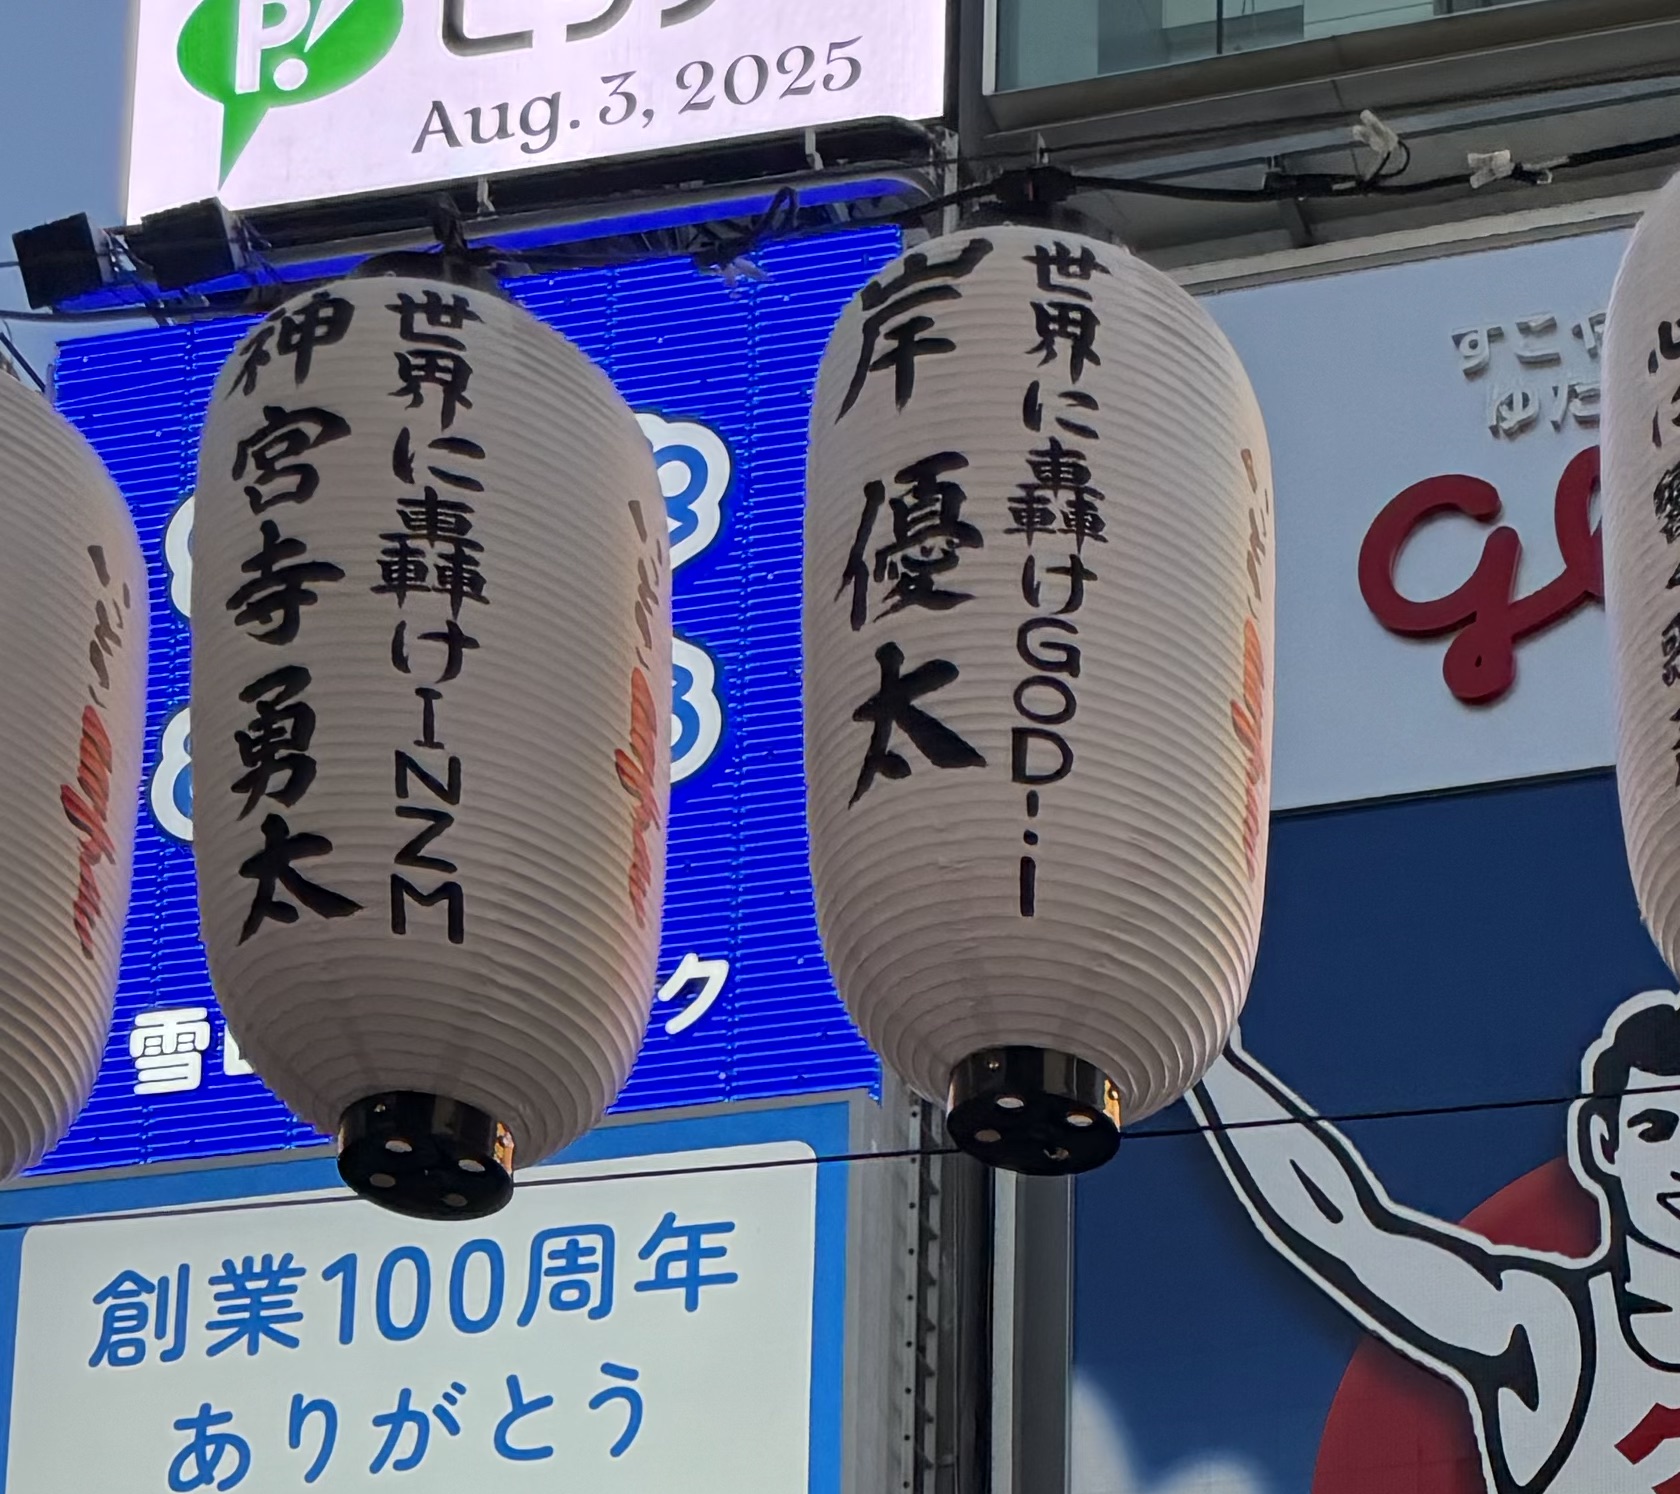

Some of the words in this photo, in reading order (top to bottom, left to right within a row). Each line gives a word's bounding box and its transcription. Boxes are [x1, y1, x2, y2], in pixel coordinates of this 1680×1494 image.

[410, 90, 582, 154] Aug.
[599, 71, 654, 132] 3,
[674, 35, 864, 114] 2025
[834, 237, 993, 810] 岸優太
[227, 290, 363, 946] 神宮寺勇太
[87, 1210, 740, 1369] 創業100周年
[166, 1361, 645, 1494] ありがとう
